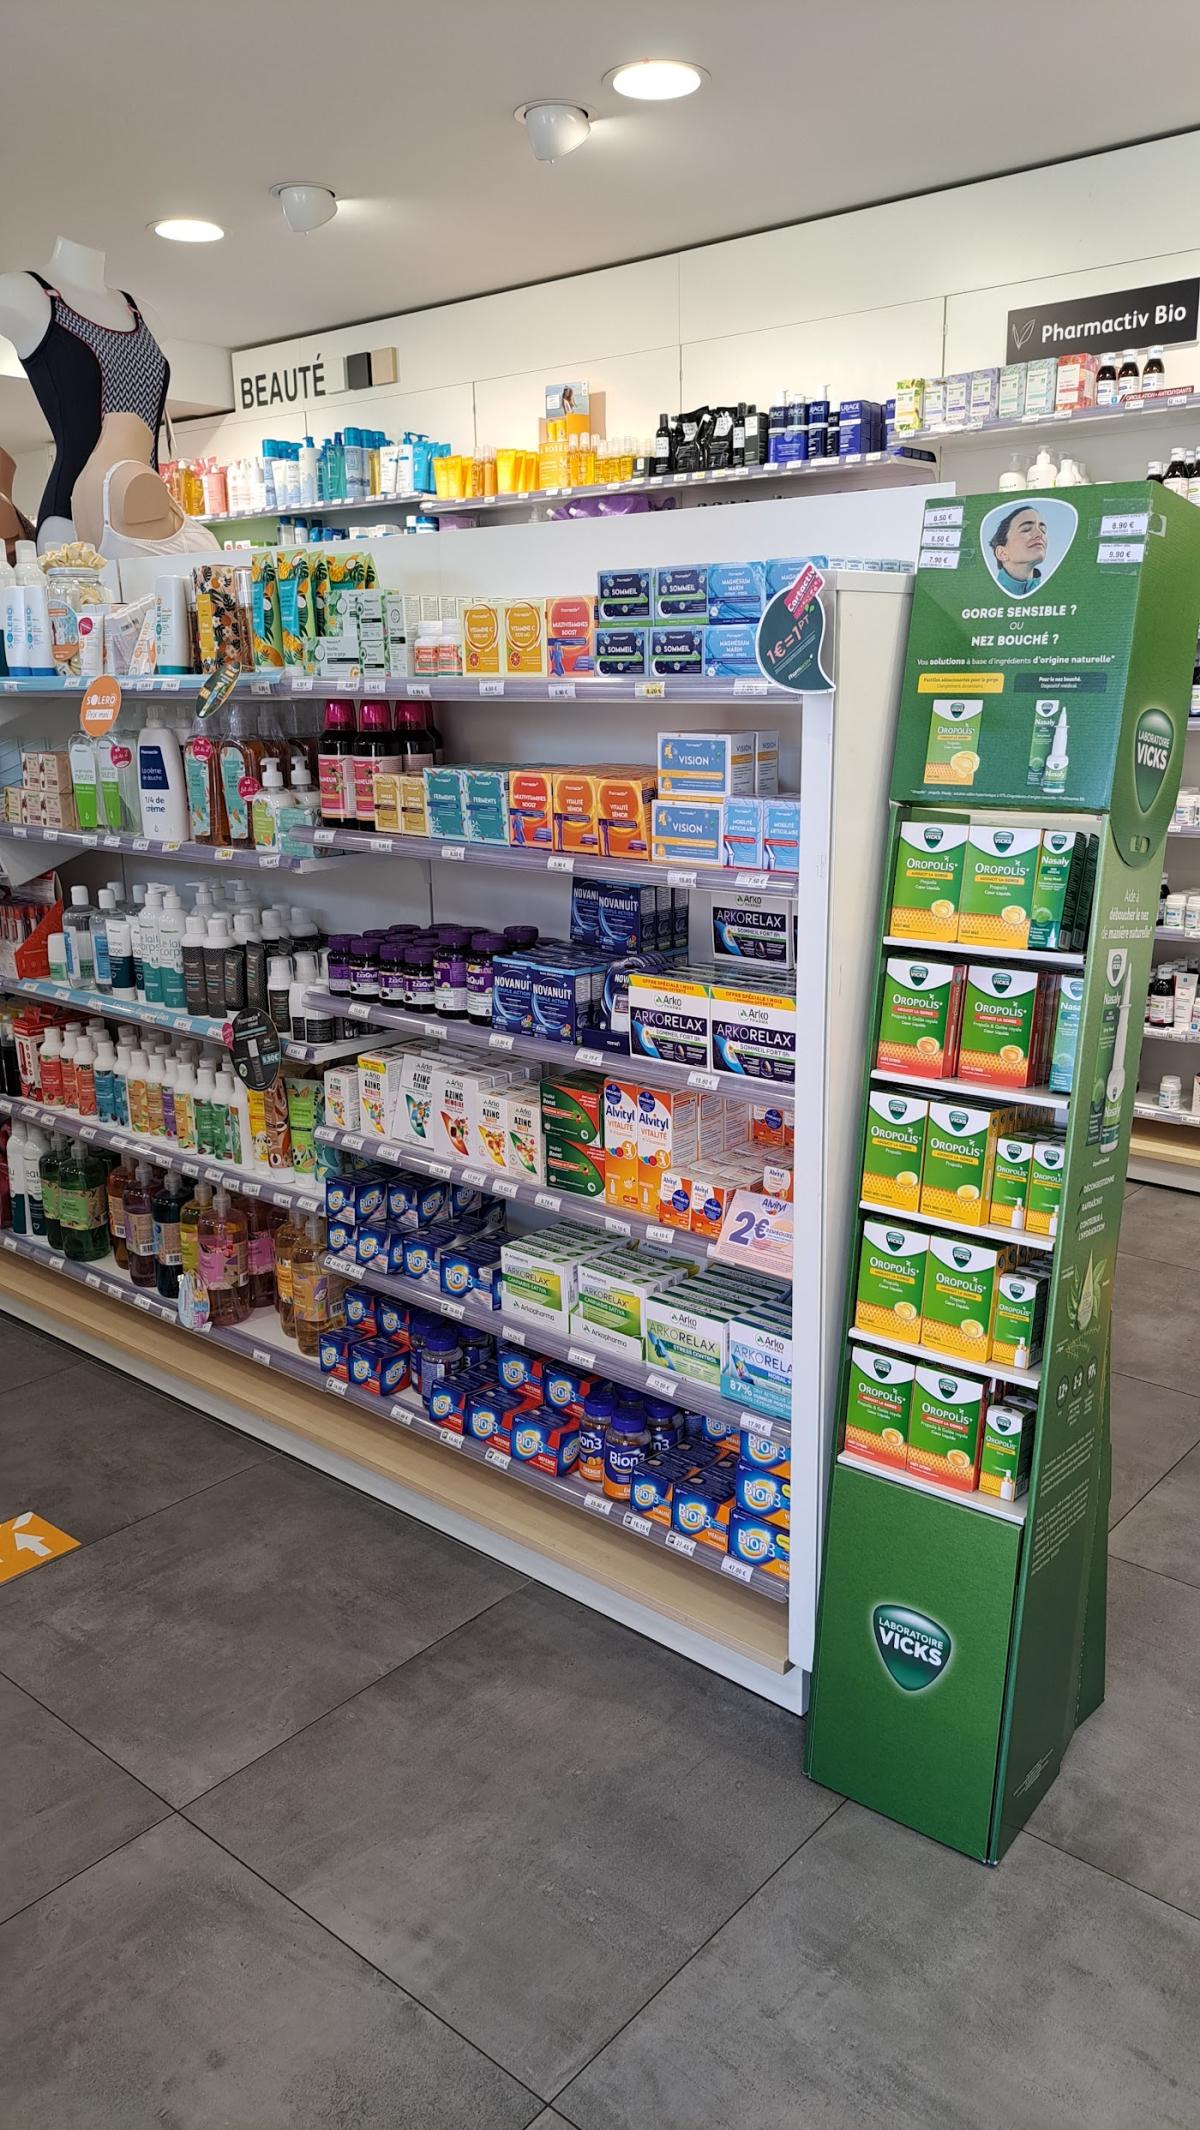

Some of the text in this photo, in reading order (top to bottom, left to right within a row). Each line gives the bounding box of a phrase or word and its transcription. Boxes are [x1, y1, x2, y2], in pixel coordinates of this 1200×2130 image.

[1042, 304, 1186, 343] Pharmactiv Bio
[241, 353, 326, 410] BEAUTÉ
[612, 588, 638, 596] SOMMEIL
[669, 584, 696, 592] SOMMEIL
[962, 604, 1078, 619] GORGE SENSIBLE ?
[1009, 622, 1024, 630] OU
[971, 632, 1060, 647] NEZ BOUCHÉ ?
[608, 645, 633, 653] SOMMEIL
[664, 645, 690, 653] SOMMEIL
[930, 657, 965, 665] solutions
[988, 657, 1032, 667] d'ingrédients
[1033, 655, 1070, 667] d'origine
[87, 695, 116, 706] SOLERO
[1138, 730, 1171, 748] LABORATOIRE
[678, 755, 710, 766] VISION
[1137, 742, 1168, 771] VICKS
[672, 822, 703, 834] VISION
[1041, 856, 1070, 867] Nasaly
[599, 896, 638, 911] NOVANUIT
[744, 895, 762, 904] Arko
[716, 910, 782, 928] ARKORELAX
[533, 984, 572, 1000] NOVANUIT
[663, 996, 682, 1007] Arko
[634, 1010, 705, 1032] ARKORELAX
[749, 1009, 769, 1020] Arko
[716, 1024, 793, 1047] ARKORELAX
[445, 1090, 464, 1102] AZINC
[482, 1109, 500, 1119] AZINC
[606, 1104, 634, 1121] Alvityl
[514, 1117, 532, 1128] AZINC
[638, 1112, 669, 1131] Alvityl
[641, 1127, 667, 1141] VITALITÉ
[762, 1197, 788, 1212] Alvityl
[507, 1266, 550, 1286] ARKORELAX
[584, 1286, 629, 1308] ARKORELAX
[521, 1304, 555, 1321] Arkopharma
[678, 1313, 697, 1327] Arko
[591, 1329, 627, 1348] Arkopharma
[649, 1321, 716, 1353] ARKORELAX
[765, 1336, 785, 1351] Arko
[734, 1345, 792, 1374] ARKORELA
[729, 1379, 753, 1397] 87%
[516, 1430, 544, 1454] Bion3
[744, 1479, 781, 1508] Bion3
[679, 1503, 711, 1528] Bion3
[738, 1529, 776, 1557] Bion3
[879, 1617, 944, 1650] LABORATOIRE
[879, 1626, 942, 1666] VICKS
